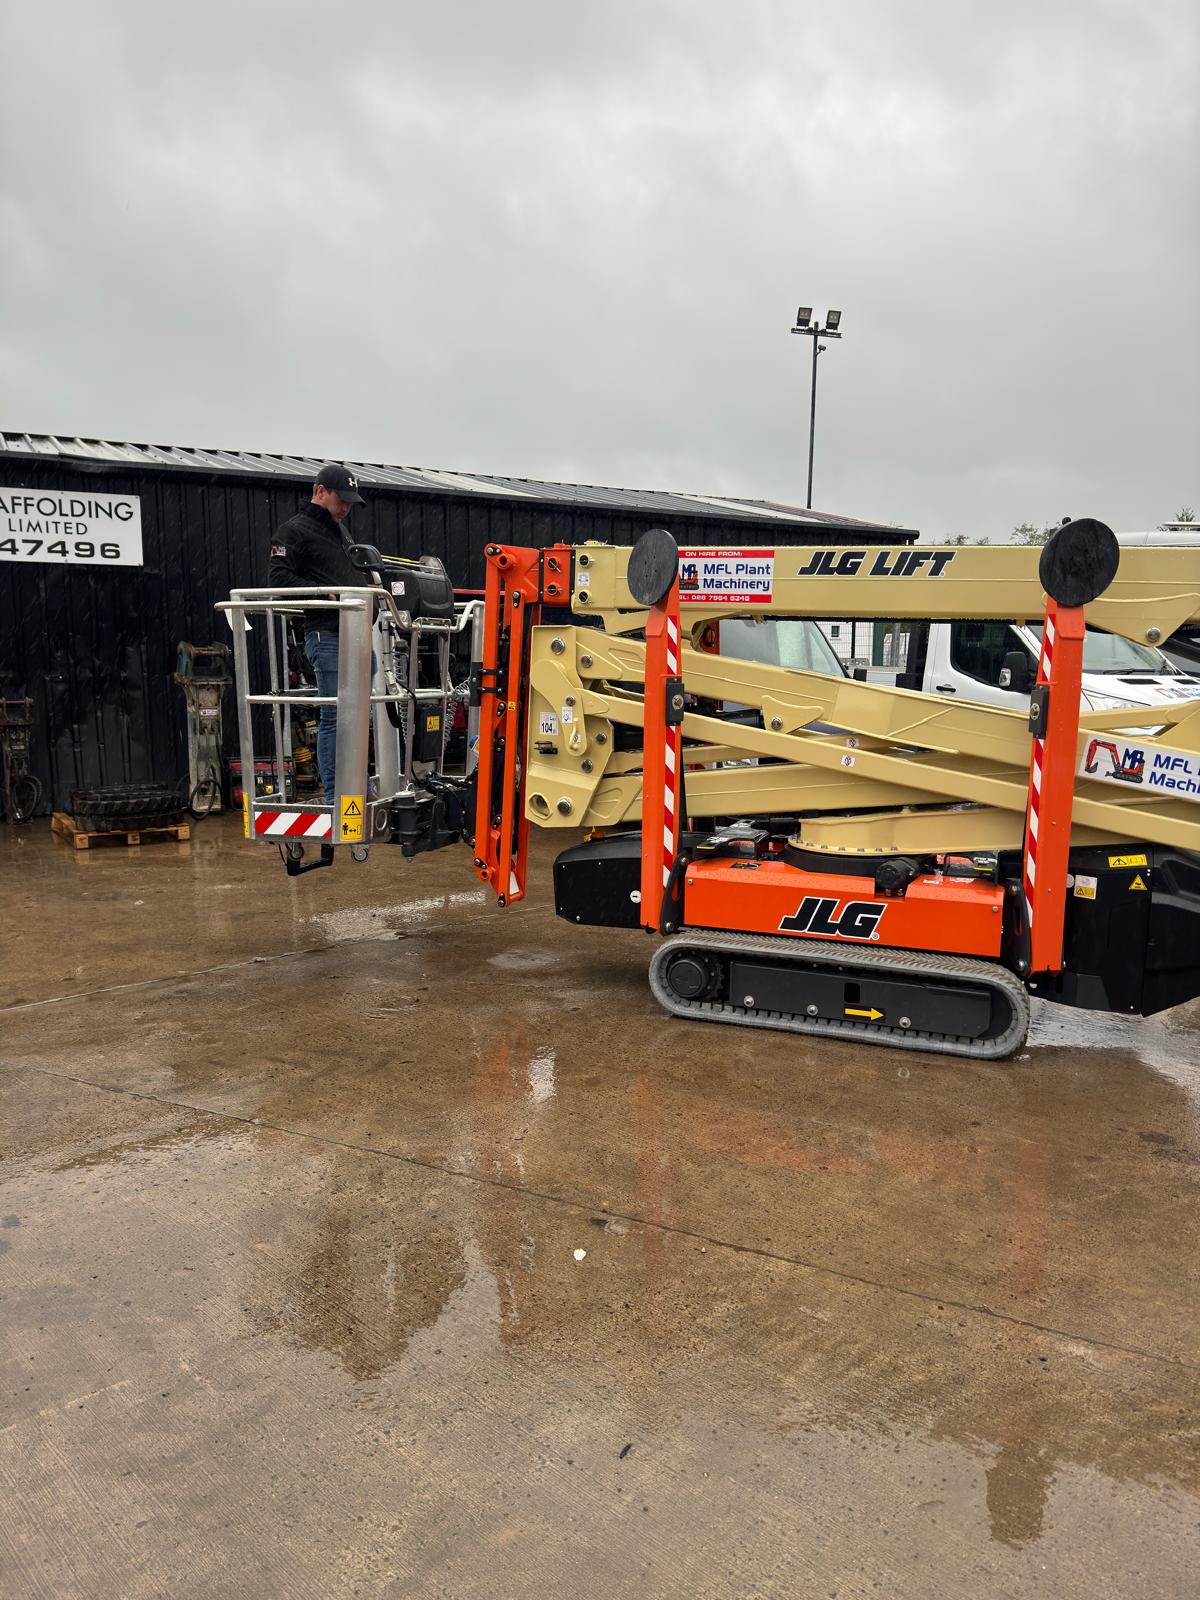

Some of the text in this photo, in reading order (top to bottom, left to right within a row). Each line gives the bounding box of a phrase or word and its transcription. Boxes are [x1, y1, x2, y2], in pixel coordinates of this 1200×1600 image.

[8, 518, 88, 535] LIMITED
[0, 538, 121, 559] 47496
[703, 563, 771, 575] MFL Plant
[797, 551, 957, 577] JLG LIFT
[703, 578, 770, 592] Machinery
[541, 722, 553, 733] 104
[1153, 753, 1193, 775] MFL
[777, 896, 889, 940] JLG
